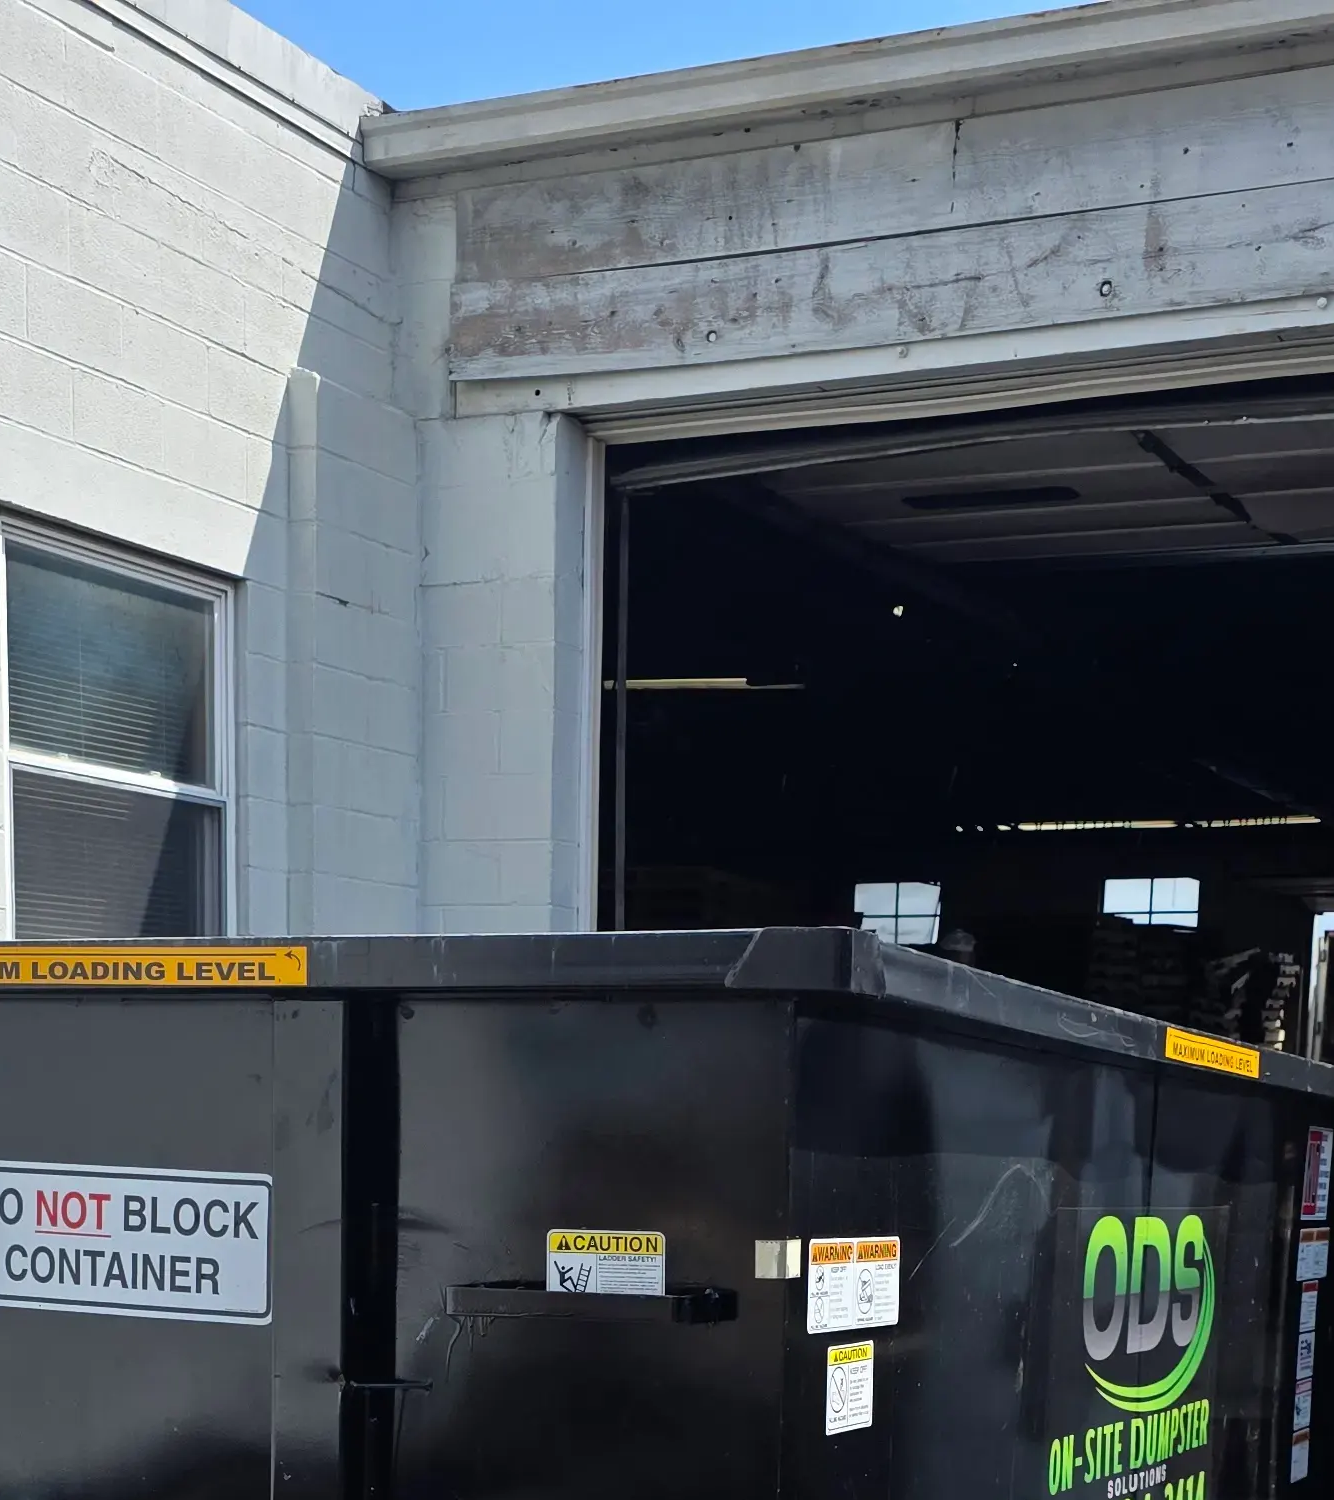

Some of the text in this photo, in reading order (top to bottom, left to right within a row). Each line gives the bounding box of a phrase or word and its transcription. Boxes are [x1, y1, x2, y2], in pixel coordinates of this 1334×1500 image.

[30, 960, 166, 981] LOADING
[176, 961, 276, 981] LEVEL
[1172, 1041, 1253, 1073] MAXIMUM LOADING LEVEL
[36, 1189, 112, 1230] NOT
[123, 1194, 259, 1240] BLOCK
[573, 1235, 658, 1252] CAUTION
[817, 1245, 853, 1262] WARNING
[862, 1243, 897, 1259] WARNING
[4, 1244, 220, 1295] CONTAINER
[1082, 1214, 1205, 1361] ODS
[838, 1346, 868, 1361] CAUTION
[1048, 1421, 1124, 1496] ON-SITE
[1129, 1398, 1210, 1470] DUMPSTER
[1107, 1463, 1167, 1499] SOLUTIONS
